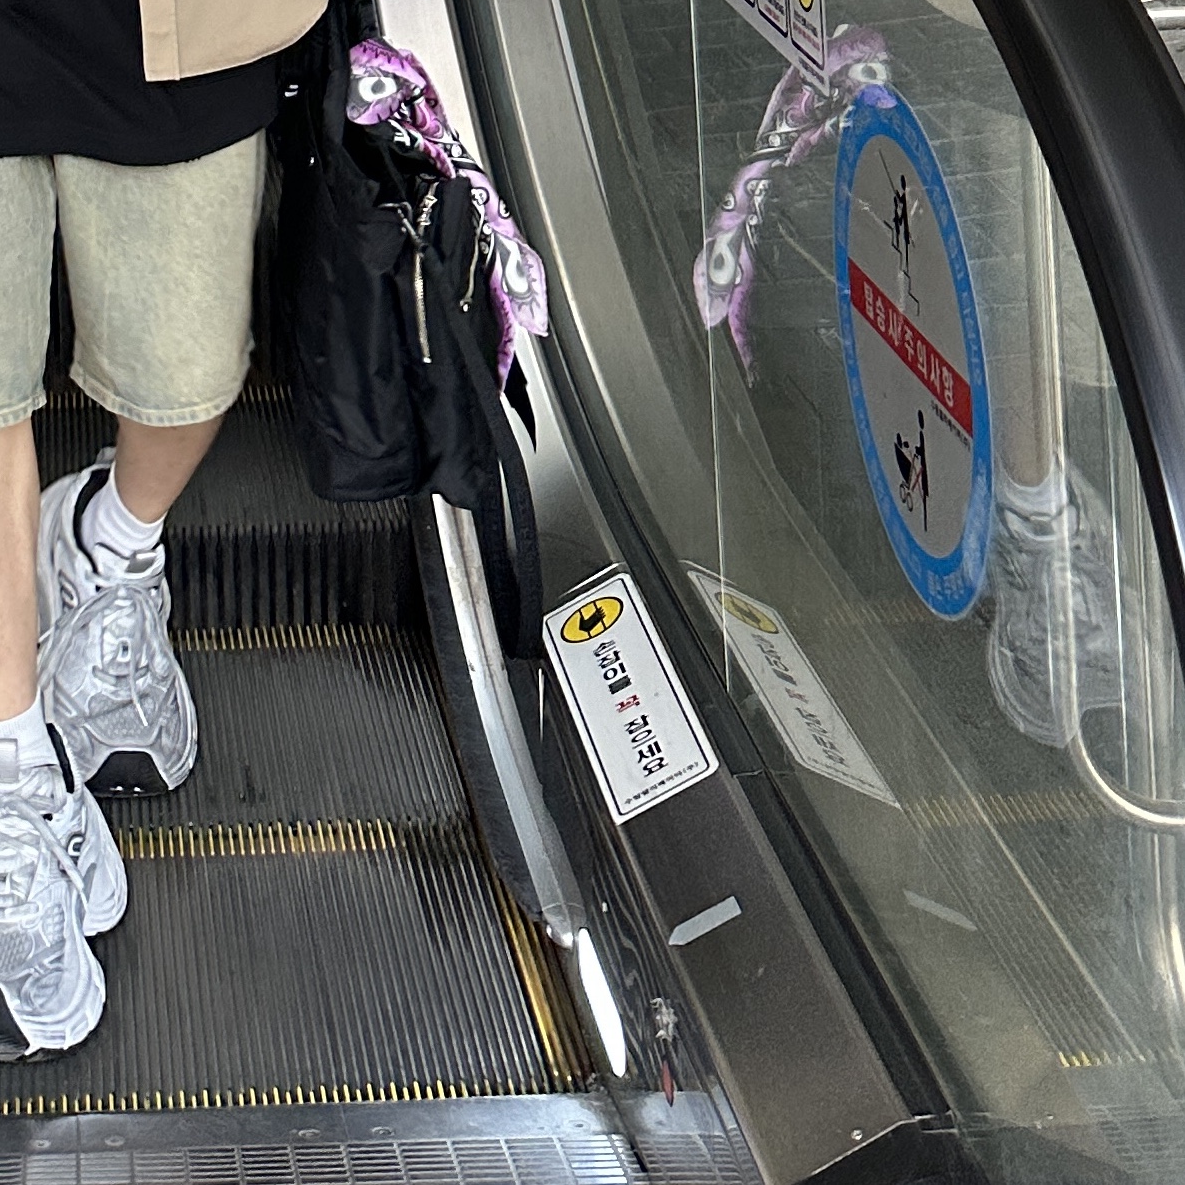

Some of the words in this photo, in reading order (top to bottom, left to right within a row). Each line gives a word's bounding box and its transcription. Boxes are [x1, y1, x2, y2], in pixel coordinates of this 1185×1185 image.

[901, 324, 955, 407] 주의사항
[592, 639, 632, 695] 손잡이를
[615, 695, 641, 713] 꼭
[623, 713, 669, 778] 잡으세요
